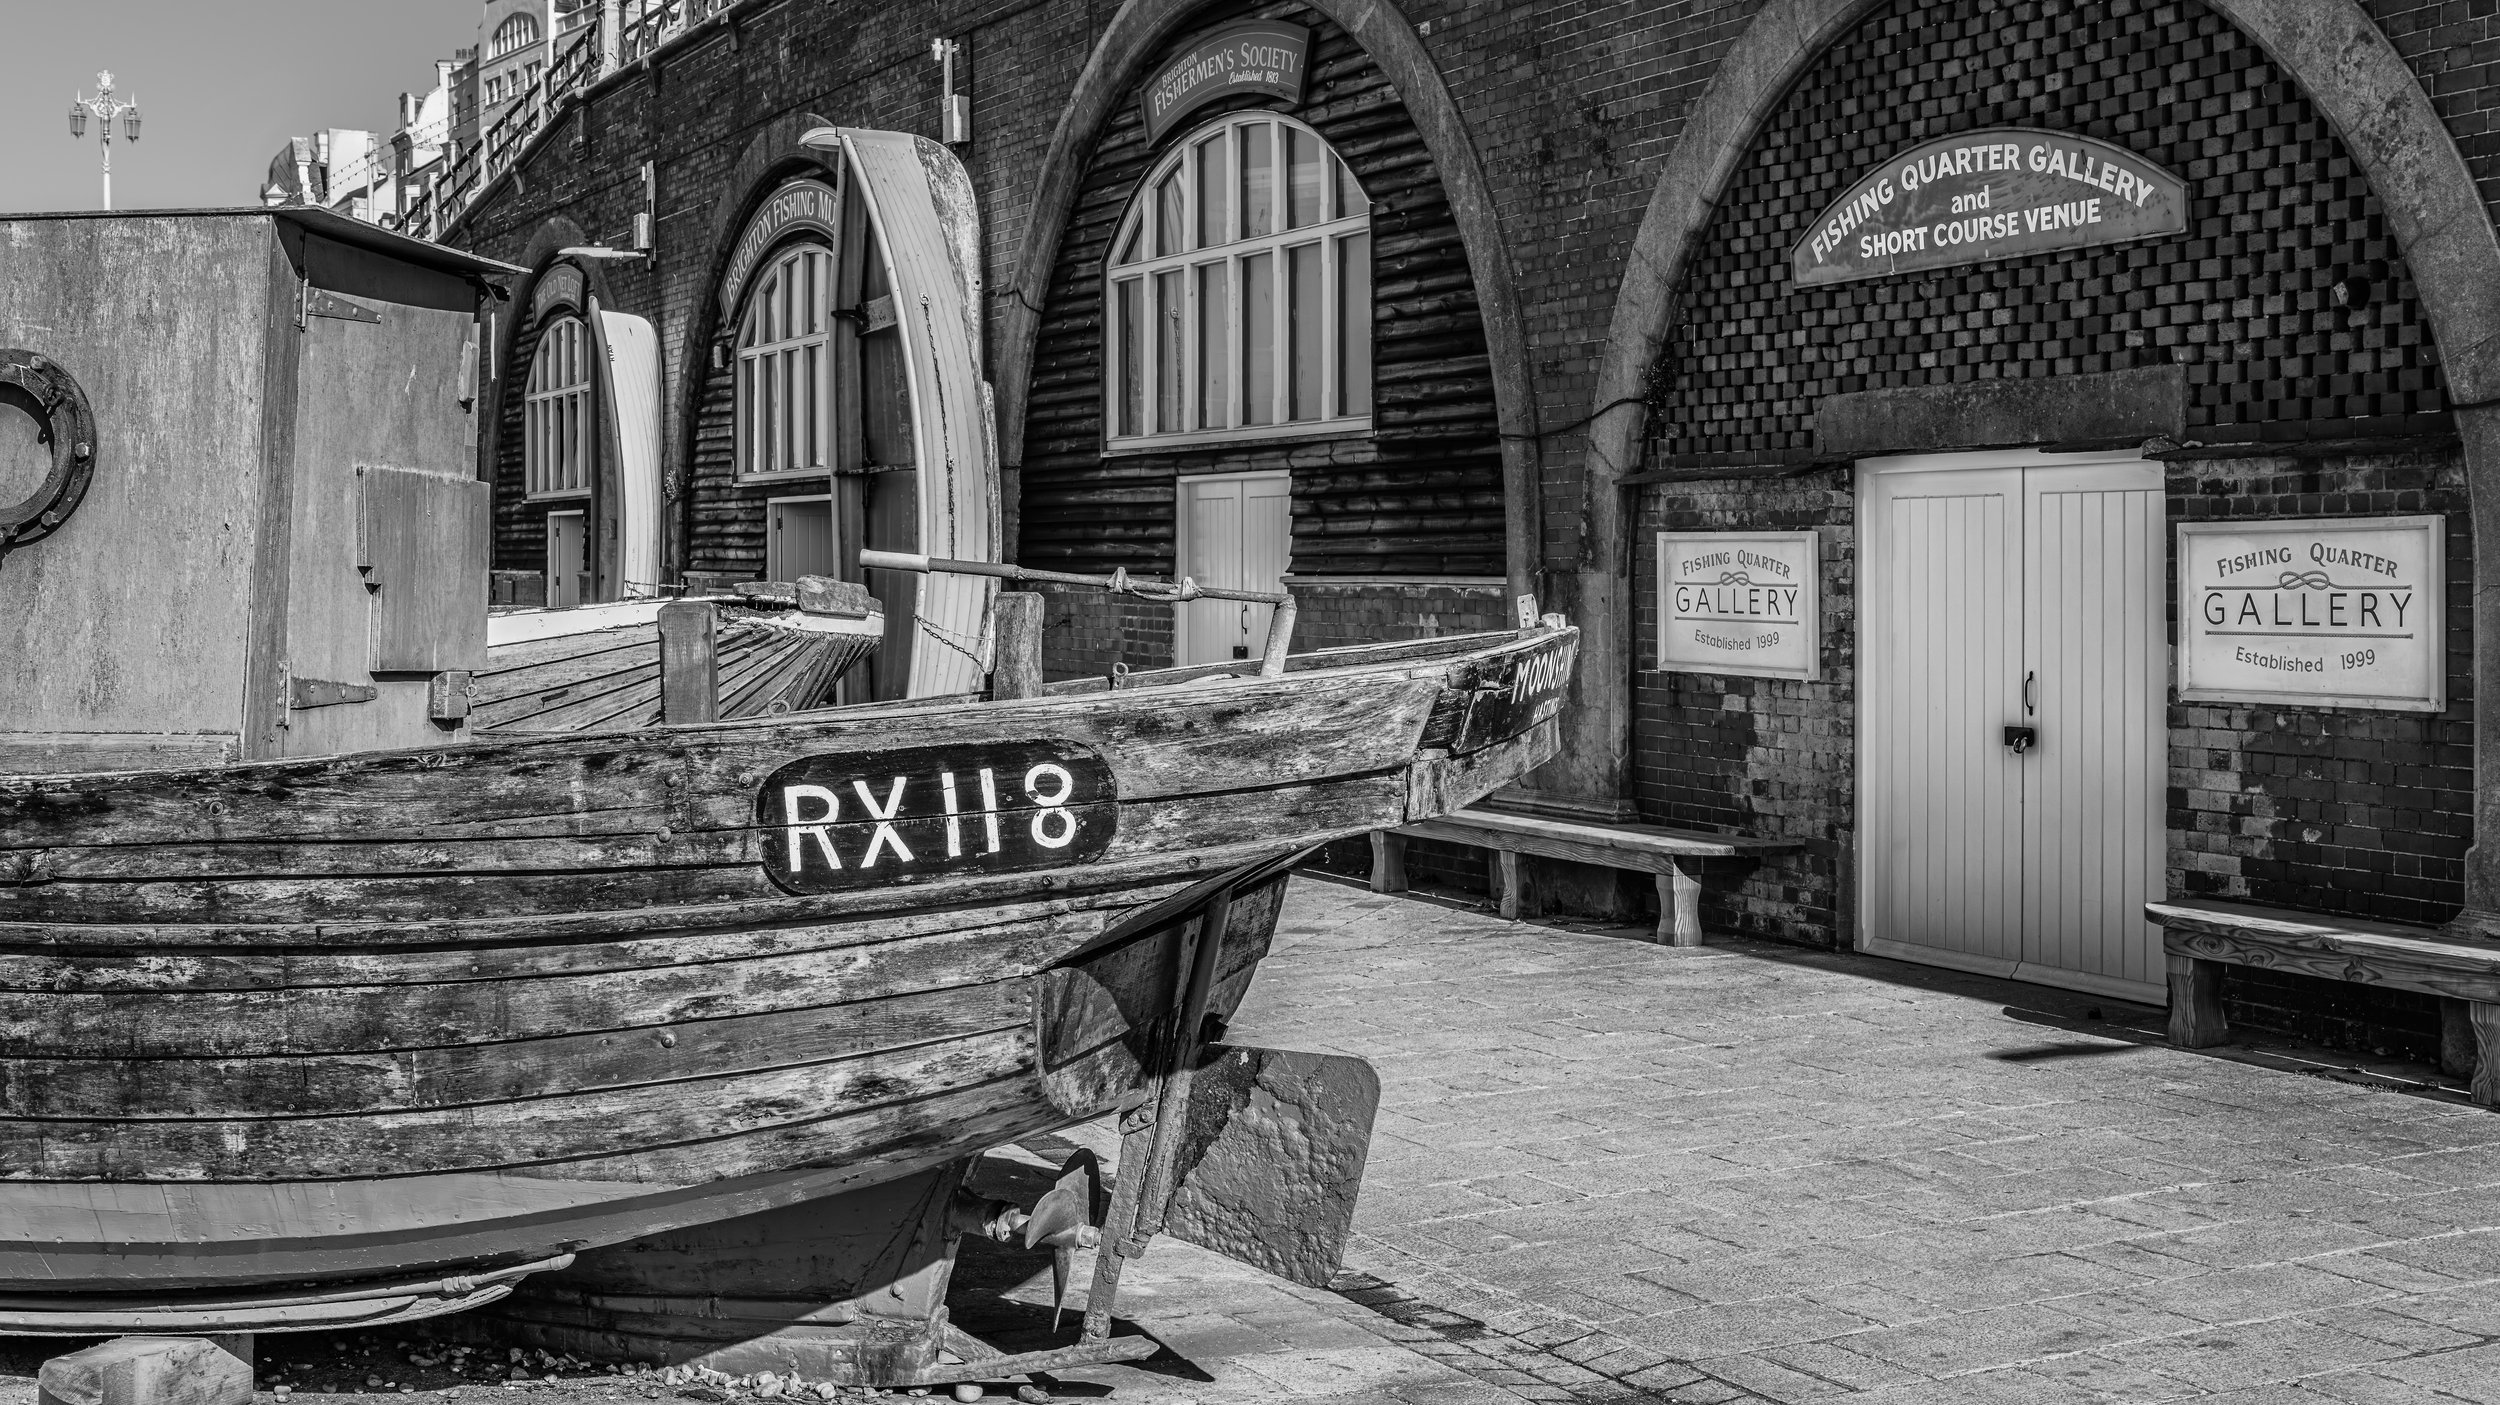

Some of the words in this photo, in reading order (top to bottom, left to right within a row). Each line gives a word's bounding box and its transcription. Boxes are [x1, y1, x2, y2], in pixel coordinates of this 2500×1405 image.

[1154, 48, 1235, 117] FISHERMEN'S
[1240, 42, 1298, 73] SOCIETY
[1162, 51, 1198, 88] BRIGHTON
[1228, 70, 1263, 85] Established
[1265, 71, 1279, 84] 1813
[1809, 178, 1895, 264] FISHING
[1900, 143, 2021, 192] QUARTER
[2028, 143, 2156, 208] GALLERY
[1950, 184, 1991, 214] and
[1859, 225, 1929, 259] SHORT
[1933, 213, 2019, 246] COURSE
[2023, 198, 2102, 234] VENUE
[726, 210, 772, 303] BRIGHTON
[773, 191, 815, 228] FISHING
[818, 191, 837, 225] MU
[1682, 551, 1731, 576] FISHING
[1737, 549, 1791, 580] QUARTER
[2217, 547, 2292, 578] FISHING
[2309, 542, 2398, 579] QUARTER
[1676, 586, 1798, 616] GALLERY
[2204, 592, 2413, 628] GALLERY
[1694, 629, 1751, 651] Established
[1757, 631, 1780, 649] 1999
[2235, 646, 2323, 673] Established
[2340, 648, 2376, 670] 1999
[783, 762, 1077, 873] RX118
